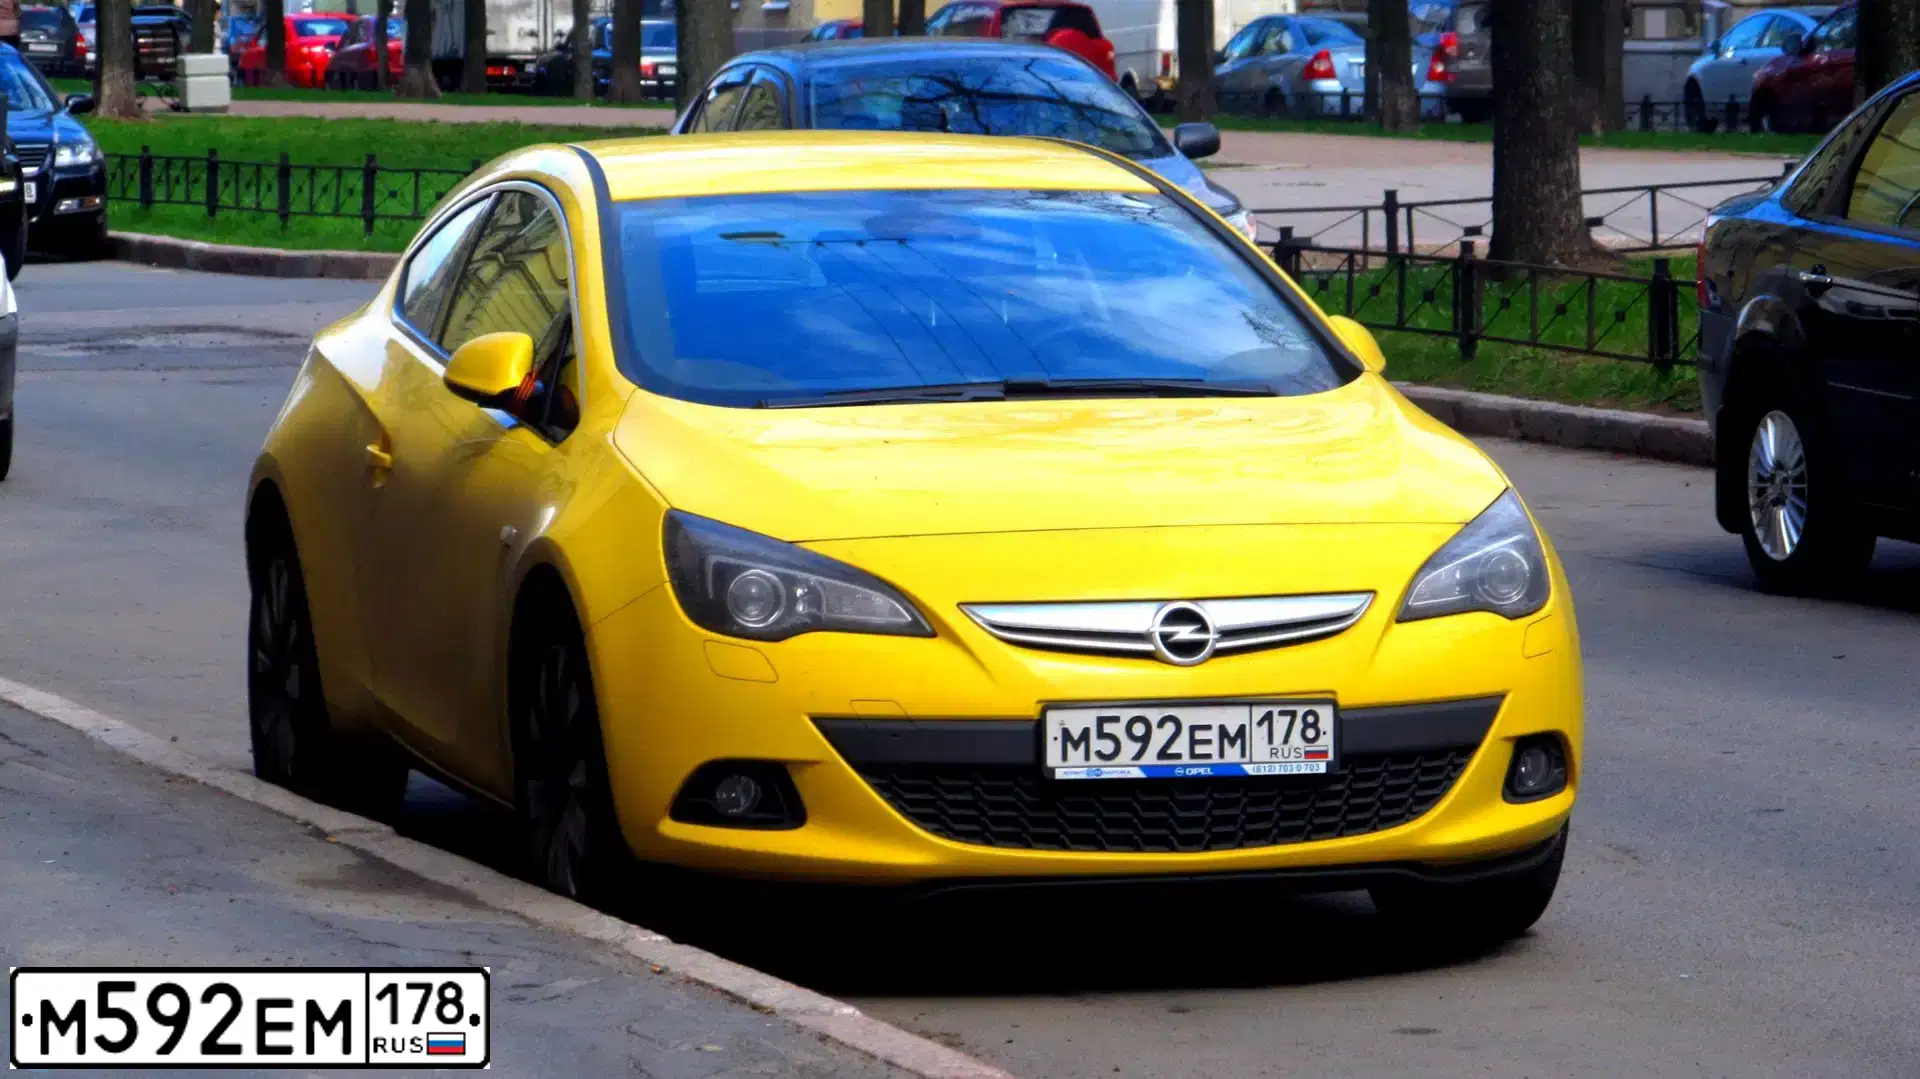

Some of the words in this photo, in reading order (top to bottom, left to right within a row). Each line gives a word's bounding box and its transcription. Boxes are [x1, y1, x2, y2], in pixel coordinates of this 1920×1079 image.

[1061, 714, 1247, 762] M592EM
[1256, 709, 1321, 745] 178
[1269, 747, 1303, 760] RUS
[1185, 767, 1214, 776] OPEL
